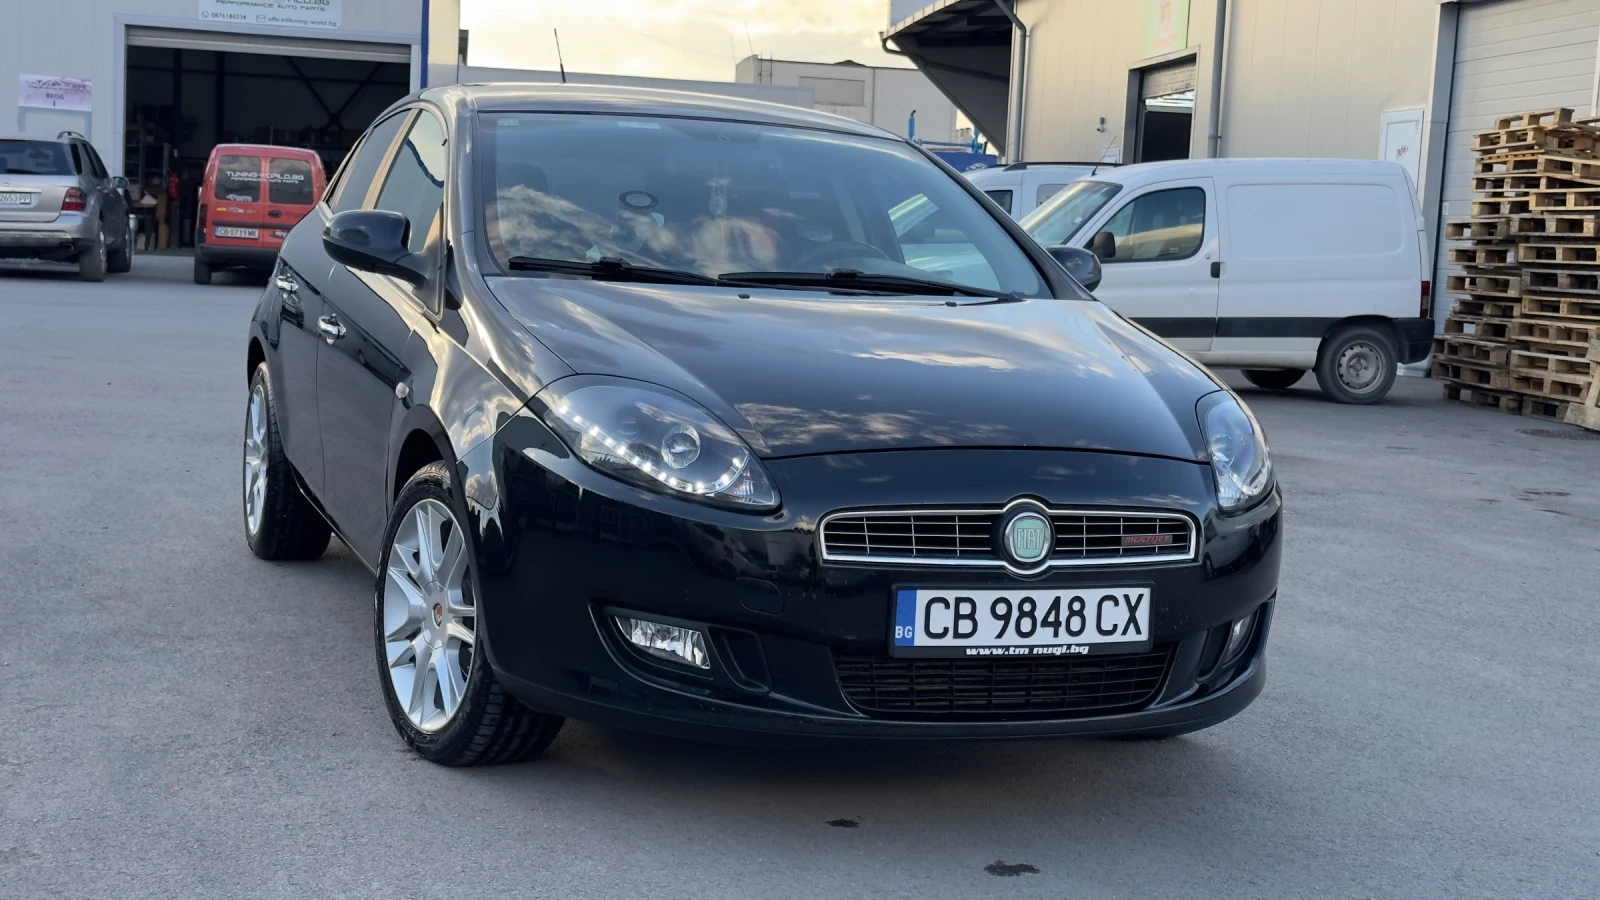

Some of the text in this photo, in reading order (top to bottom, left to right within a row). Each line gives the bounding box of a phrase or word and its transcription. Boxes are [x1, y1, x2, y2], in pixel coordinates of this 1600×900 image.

[1016, 527, 1042, 550] FIAT
[894, 593, 1145, 640] BG CB 9848 CX
